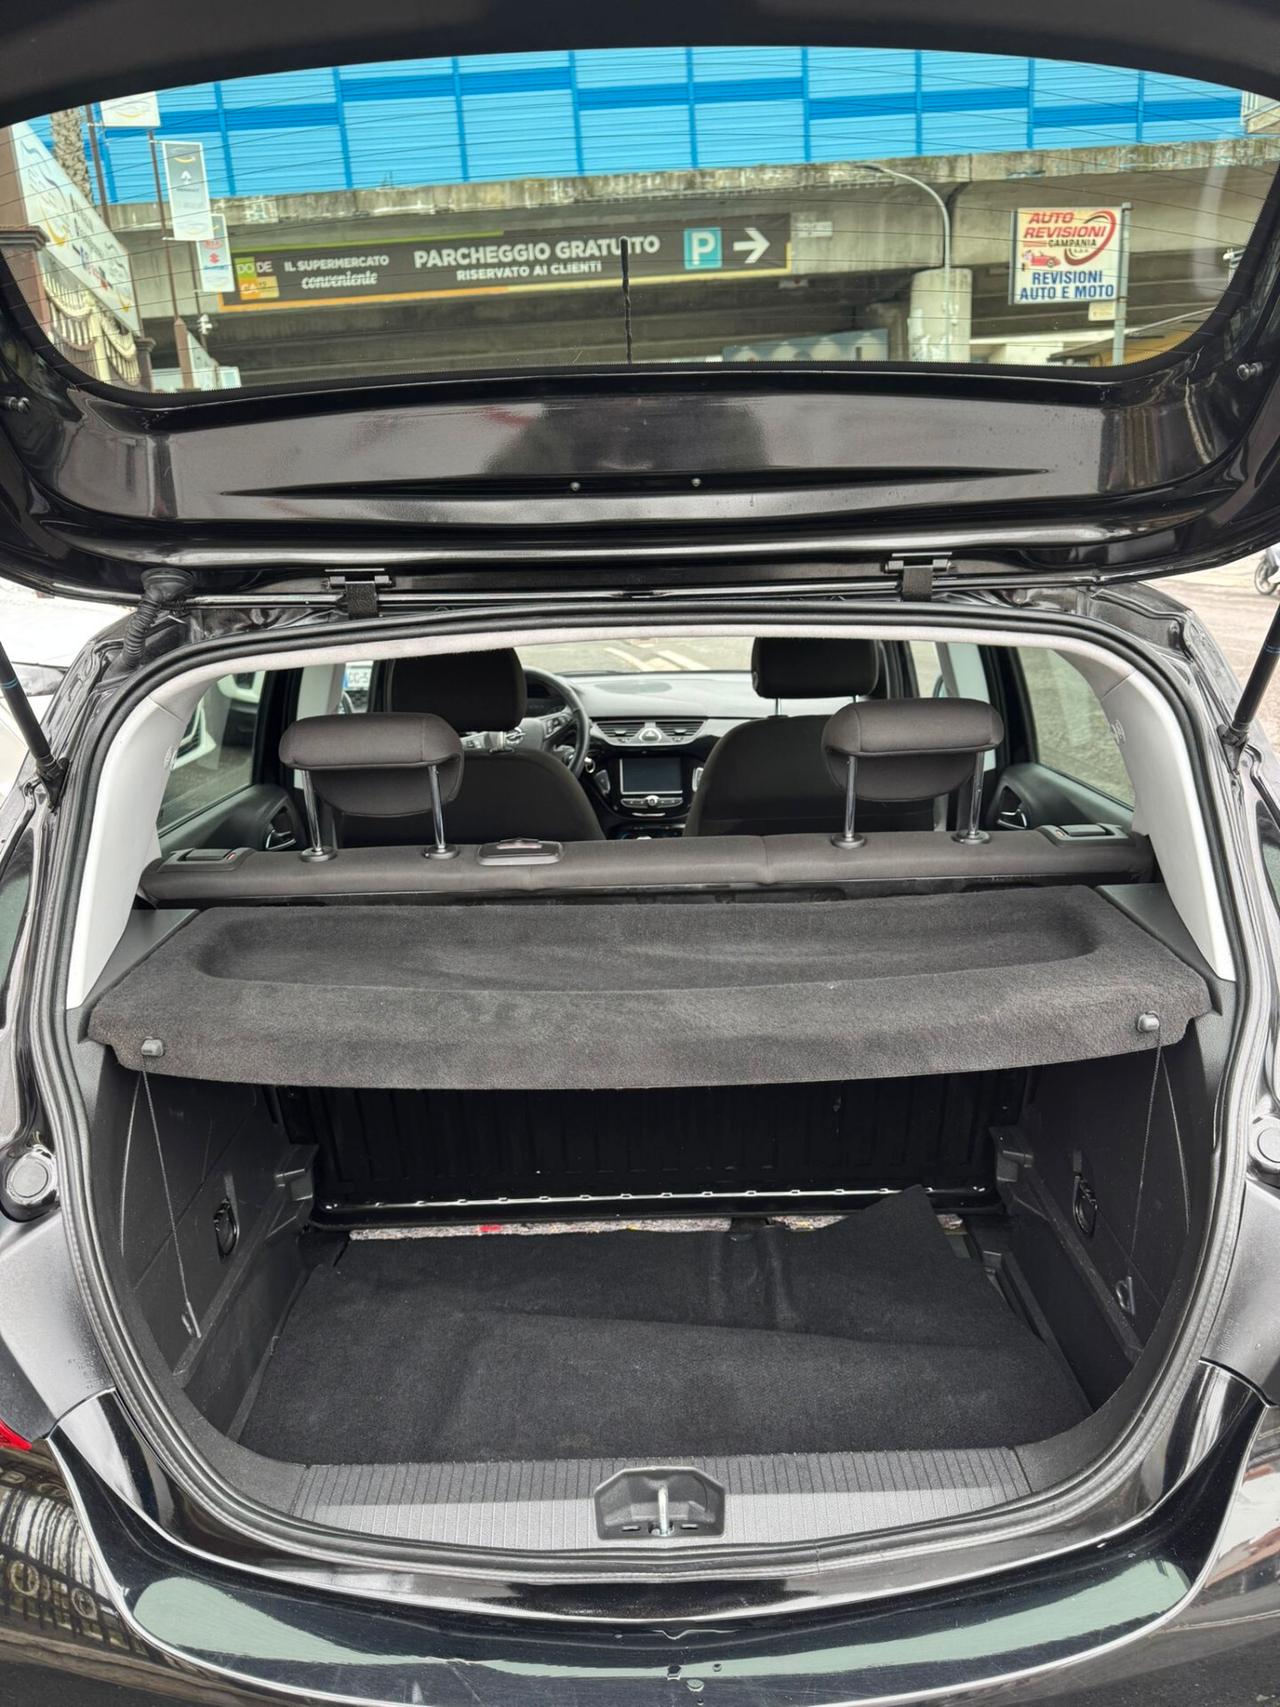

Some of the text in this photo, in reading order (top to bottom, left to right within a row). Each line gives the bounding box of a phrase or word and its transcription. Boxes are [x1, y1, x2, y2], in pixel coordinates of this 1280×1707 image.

[1029, 212, 1074, 224] AUTO
[1023, 226, 1107, 239] REVISIONI
[690, 231, 716, 266] P
[1048, 239, 1097, 248] CAMPANIA
[284, 255, 390, 272] IL SUPERMERCATO
[413, 242, 551, 269] PARCHEGGIO
[456, 261, 602, 281] RISERVATO AI CLIENTI
[1032, 271, 1103, 285] REVISIONI
[1020, 284, 1114, 300] AUTO E MOTO
